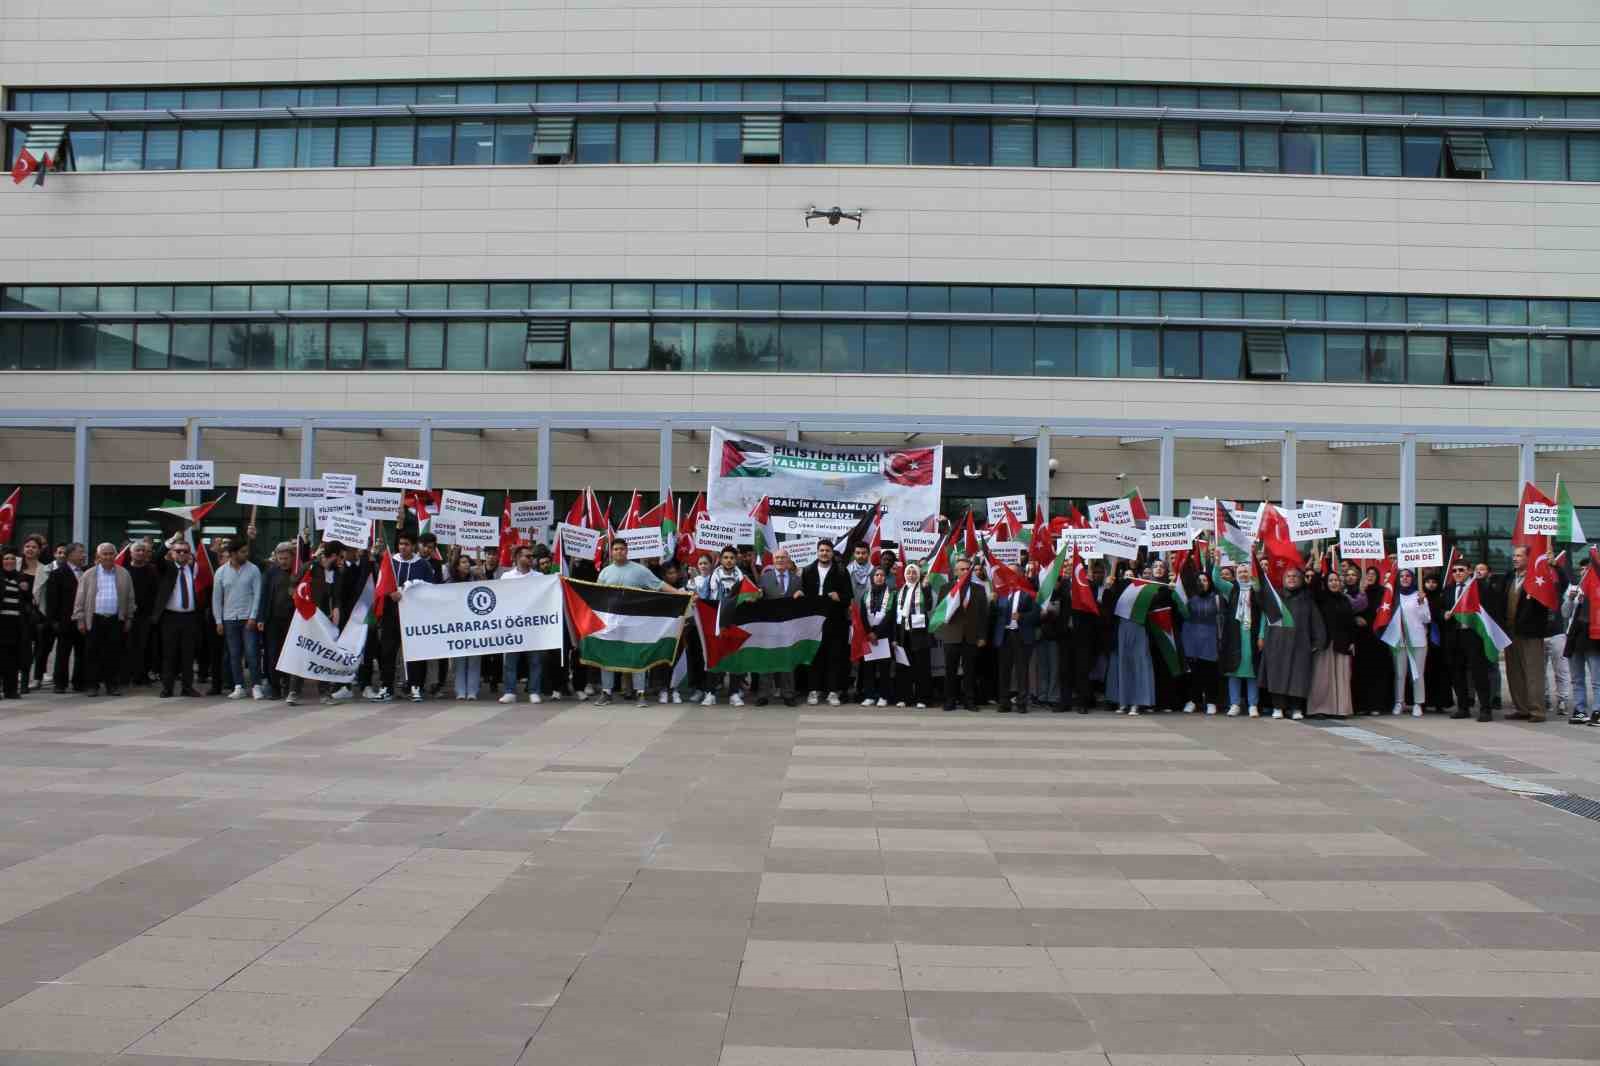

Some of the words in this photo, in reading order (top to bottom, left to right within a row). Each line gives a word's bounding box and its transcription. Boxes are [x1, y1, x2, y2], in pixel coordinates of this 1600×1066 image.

[774, 446, 833, 460] FİLİSTİN
[835, 453, 880, 463] HALKI
[388, 461, 424, 469] ÇOCUKLAR
[774, 458, 817, 469] YALNIZ
[821, 462, 878, 473] DEĞİLDİR
[390, 469, 420, 477] ÖLÜRKEN
[388, 477, 421, 486] SUSULMAZ
[768, 499, 810, 508] SRAİL'İN
[798, 511, 854, 520] KINIYORUZ!
[1297, 510, 1322, 519] DEVLET
[1149, 522, 1188, 531] GAZZE'DEKİ
[1299, 519, 1321, 527] DEĞİL
[1296, 527, 1328, 537] TERÖRİST
[405, 619, 502, 637] ULUSLARARASI
[505, 611, 559, 630] ÖĞRENCİ
[447, 634, 524, 650] TOPLULUĞU
